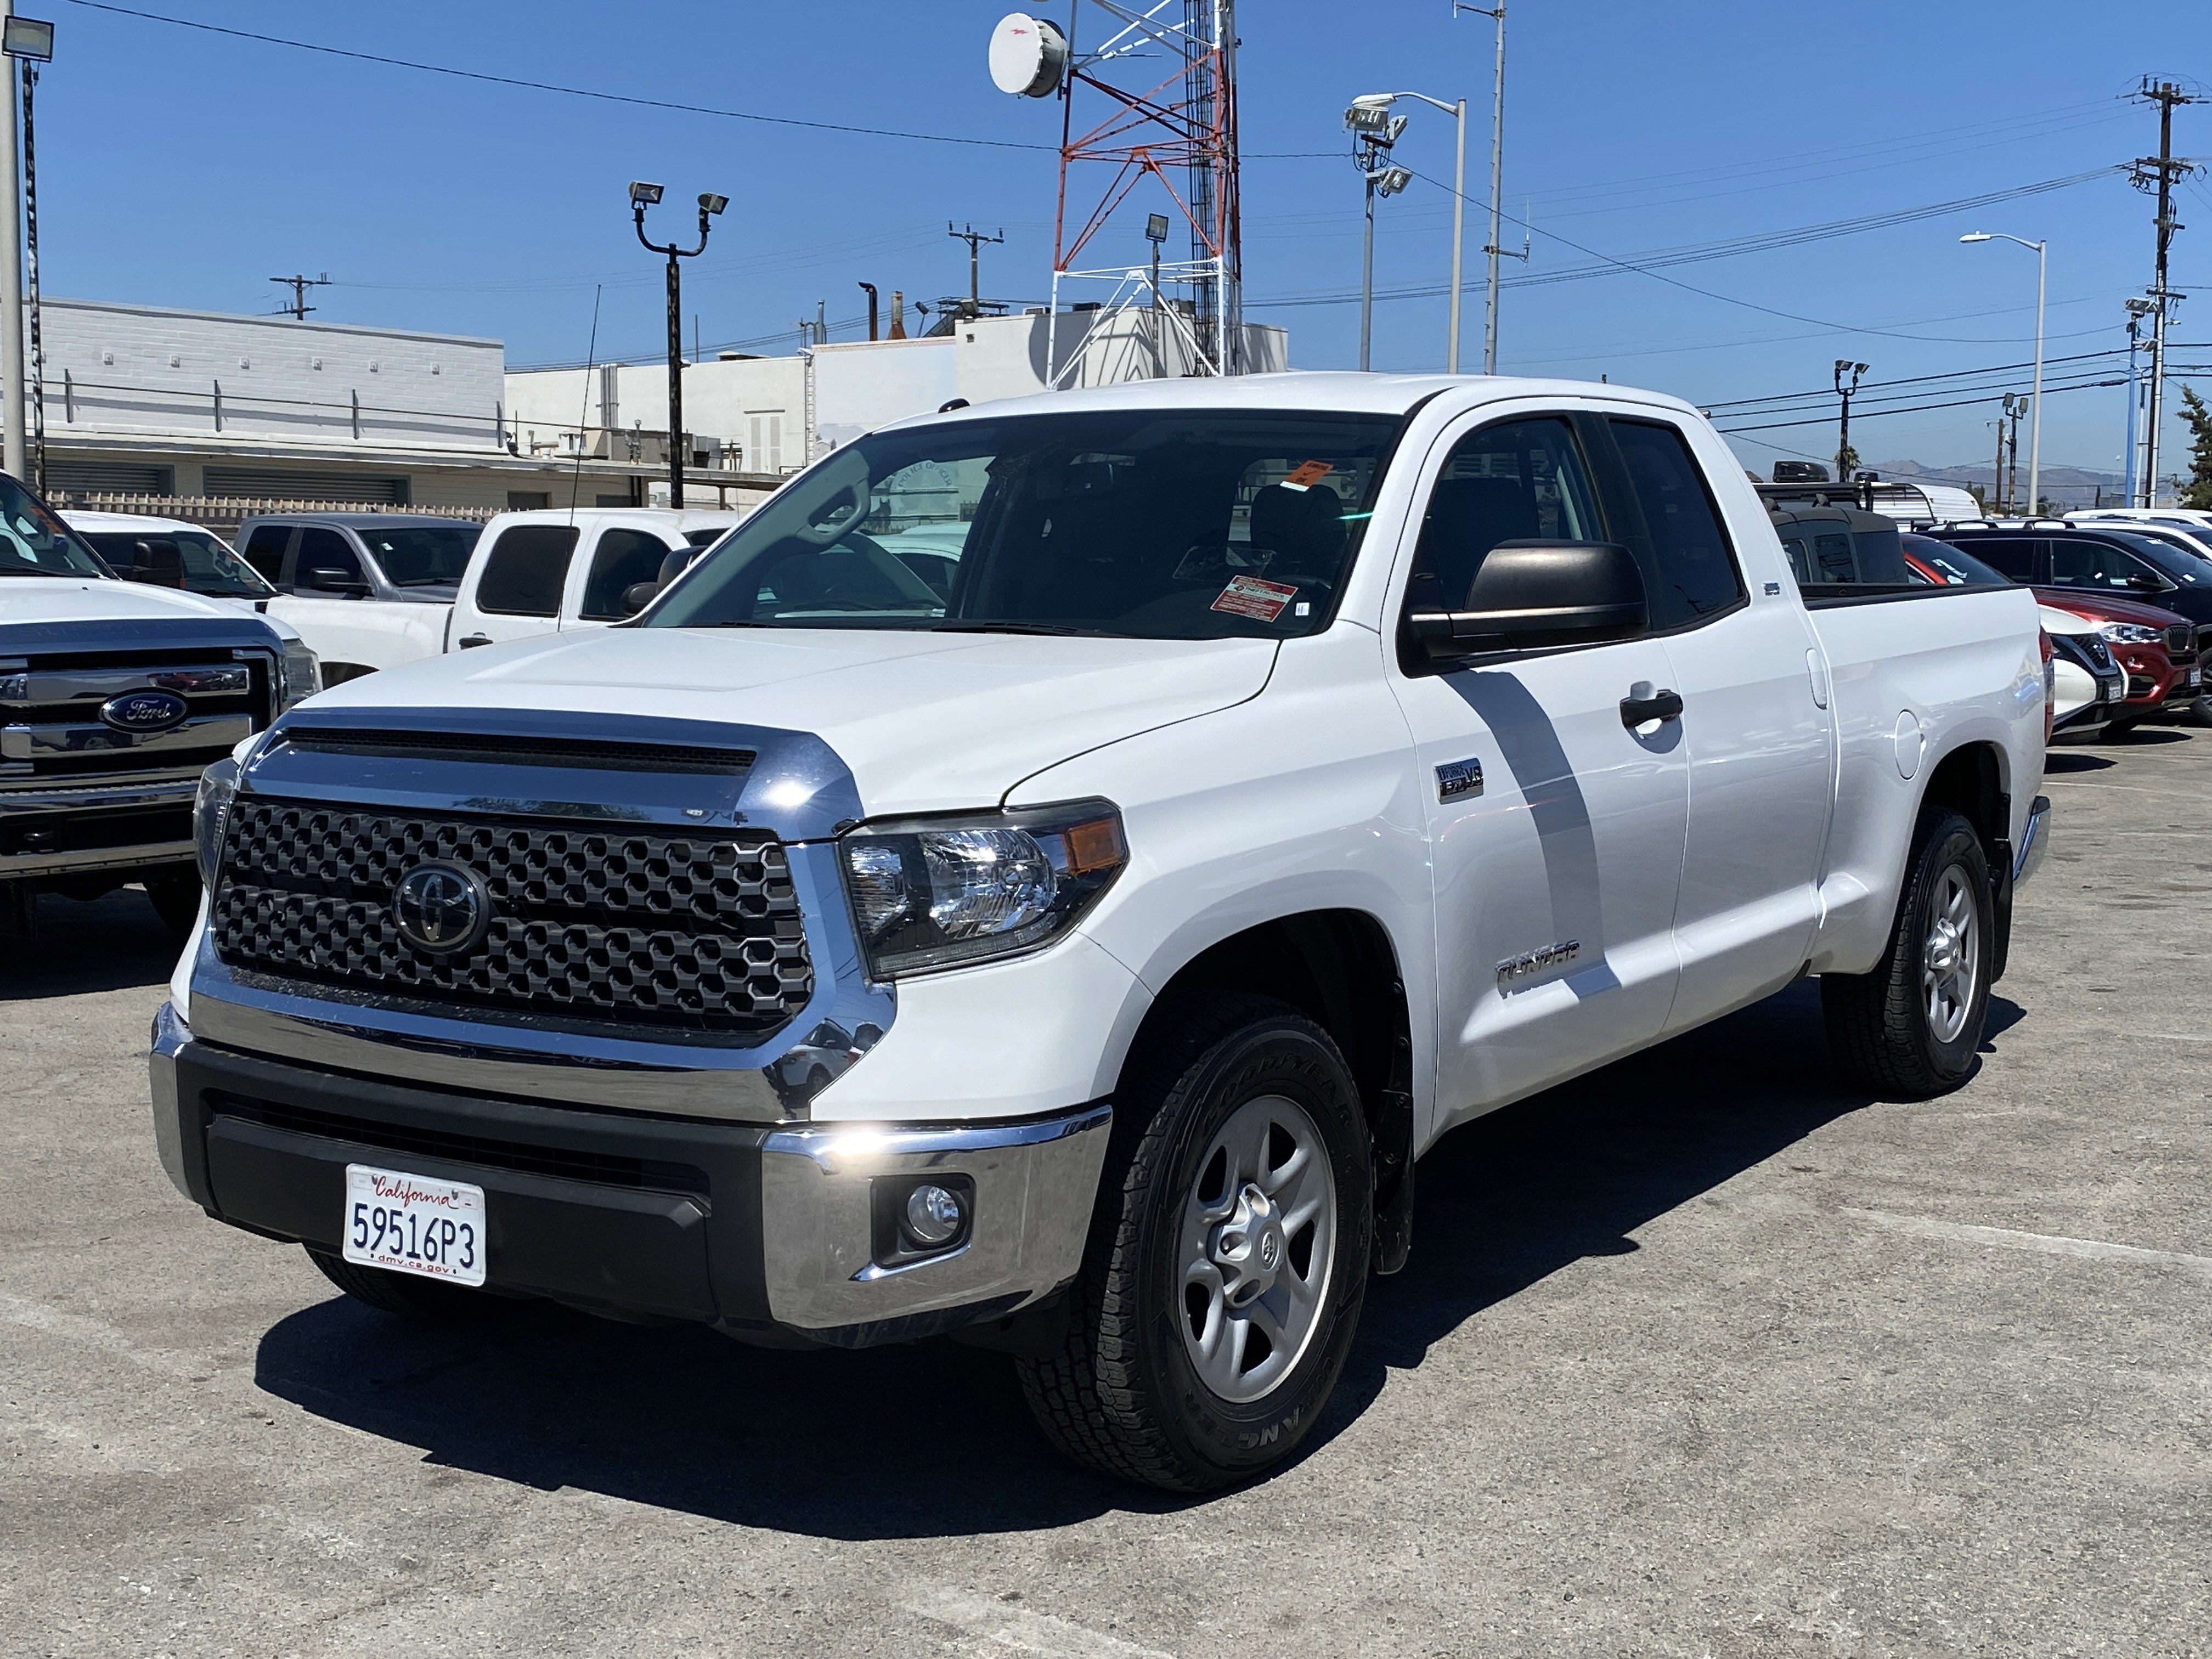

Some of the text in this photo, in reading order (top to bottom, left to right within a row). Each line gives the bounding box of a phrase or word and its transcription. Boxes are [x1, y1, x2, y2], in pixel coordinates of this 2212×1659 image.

[898, 461, 953, 488] POLICE OFFICER
[126, 699, 171, 720] Ford
[375, 1175, 459, 1210] California
[353, 1202, 475, 1268] 59516P3
[378, 1254, 450, 1274] dmv.ca.gov
